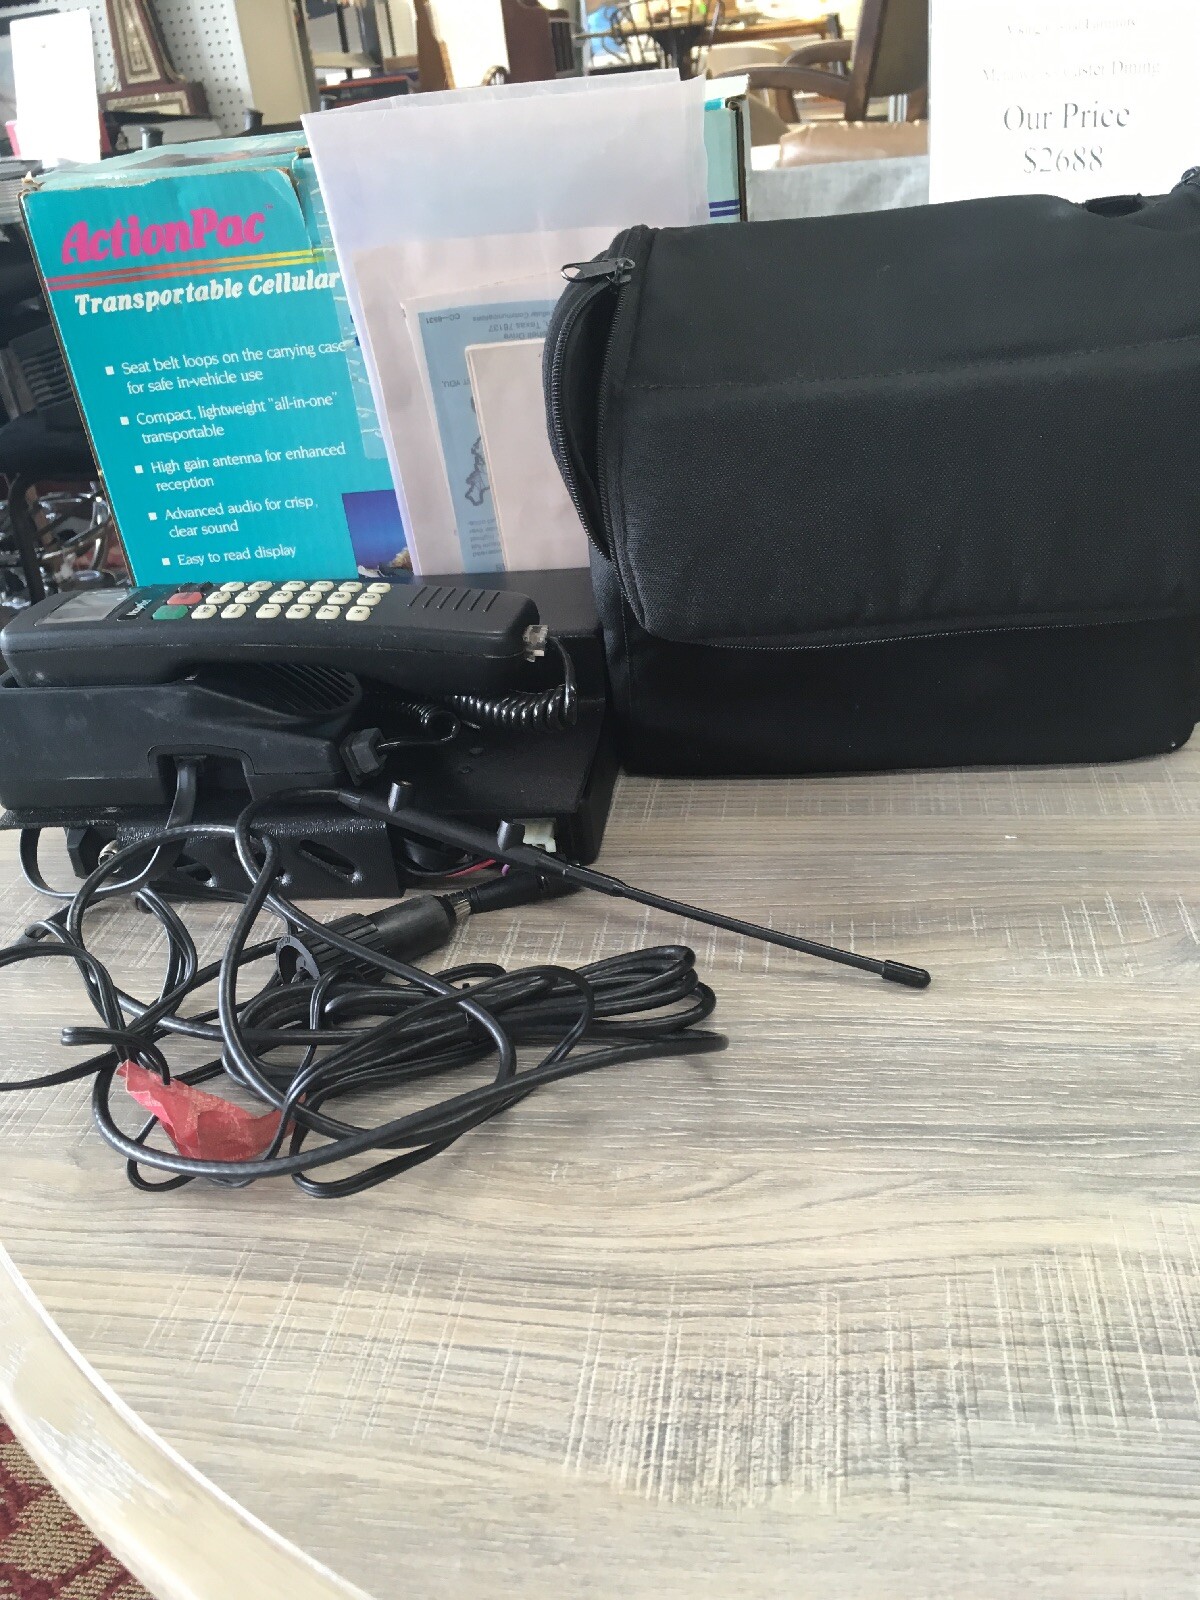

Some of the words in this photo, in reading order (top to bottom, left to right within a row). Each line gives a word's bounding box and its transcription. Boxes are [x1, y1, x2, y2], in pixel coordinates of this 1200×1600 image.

[1003, 104, 1053, 131] Our
[1062, 100, 1130, 129] Price
[1023, 145, 1104, 174] $2688
[61, 206, 266, 265] ActionPac
[75, 278, 244, 316] Transportable
[248, 269, 341, 297] Cellular
[121, 361, 151, 375] Seat
[154, 356, 181, 372] belt
[183, 353, 220, 369] loops
[222, 351, 240, 364] on
[242, 347, 264, 362] the
[266, 343, 316, 360] carrying
[318, 341, 347, 354] case
[126, 381, 145, 394] for
[148, 376, 174, 393] safe
[177, 370, 238, 389] in-vehicle
[240, 369, 264, 382] use
[136, 409, 197, 426] Compact,
[198, 400, 267, 421] lightweight
[141, 424, 225, 446] transportable
[150, 461, 180, 475] High
[184, 458, 210, 473] gain
[212, 452, 263, 469] antenna
[264, 448, 282, 462] for
[285, 442, 347, 460] enhanced
[155, 476, 215, 492] reception
[164, 502, 225, 520] Advanced
[227, 499, 263, 514] audio
[264, 497, 281, 511] for
[168, 525, 198, 538] clear
[201, 519, 239, 535] sound
[177, 554, 205, 568] Easy
[207, 551, 221, 563] to
[224, 547, 251, 562] read
[254, 543, 297, 560] display
